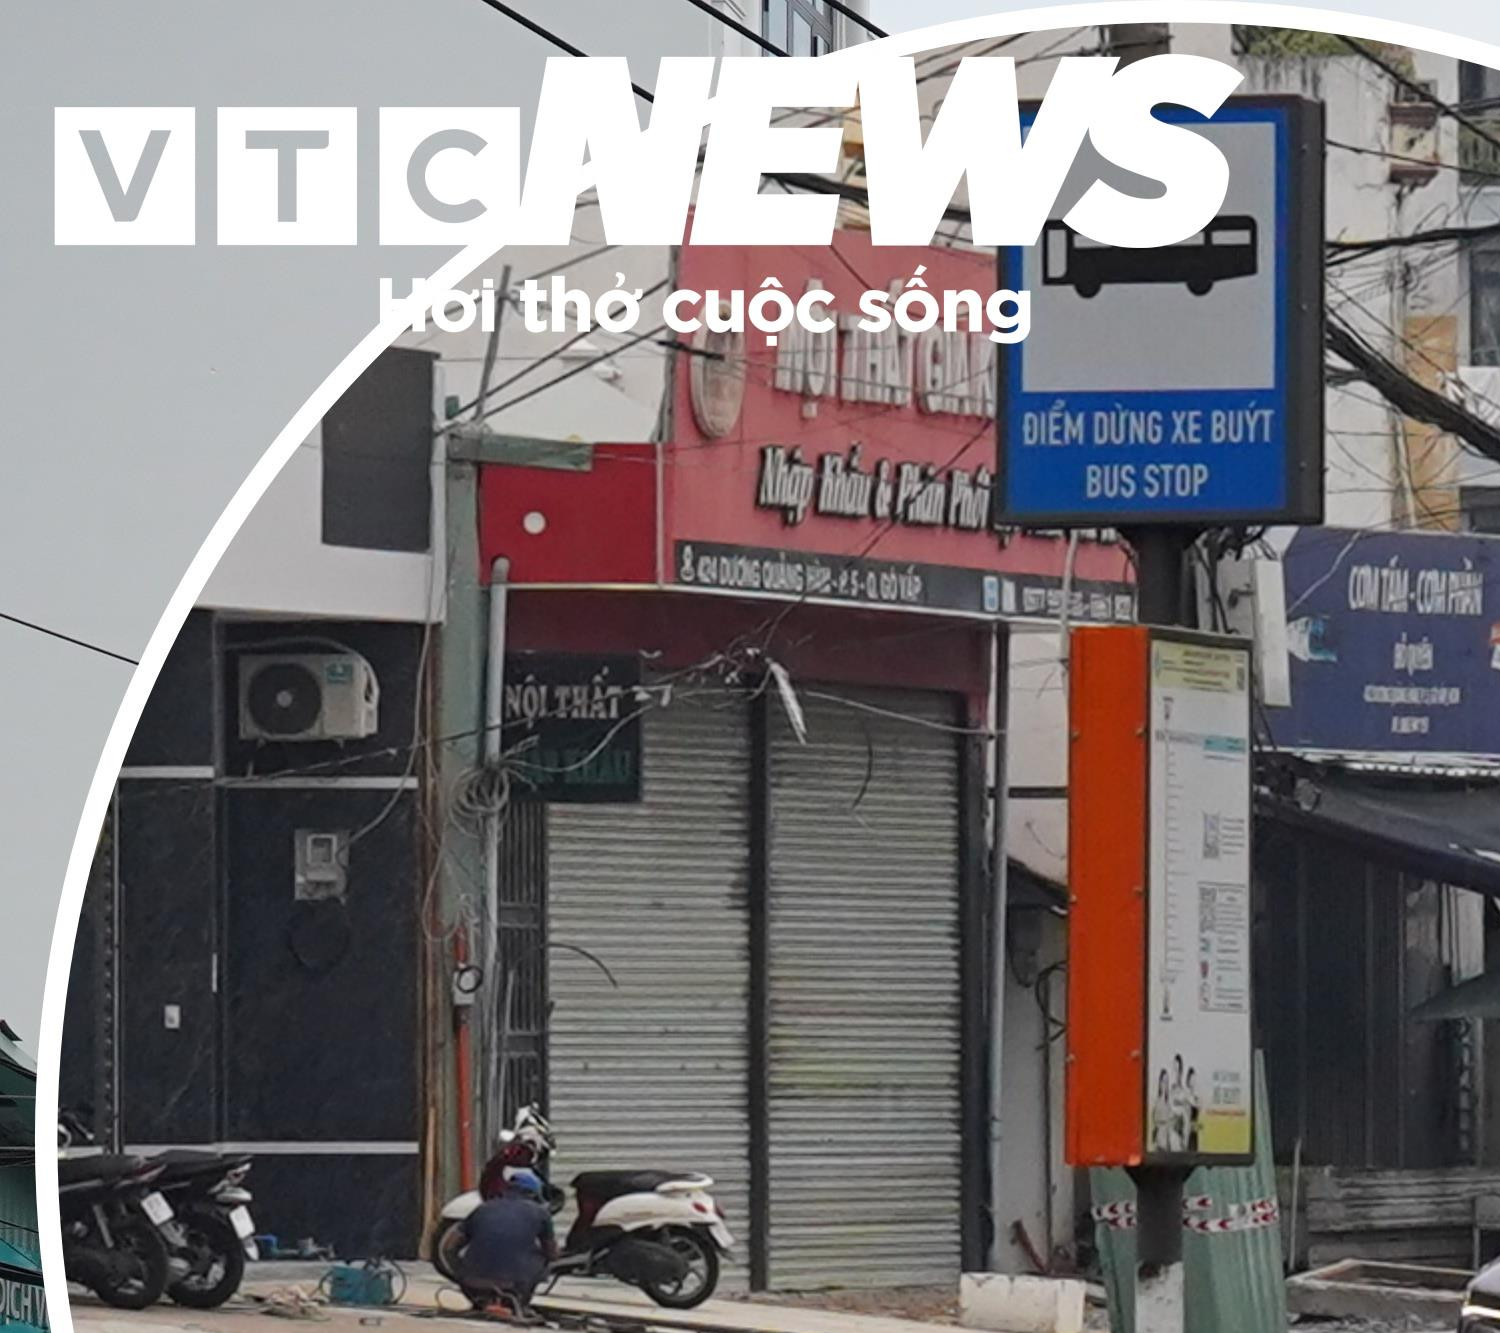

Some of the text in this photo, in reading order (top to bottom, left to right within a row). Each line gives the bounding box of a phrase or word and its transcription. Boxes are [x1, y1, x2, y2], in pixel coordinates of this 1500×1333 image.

[1022, 399, 1275, 445] ĐIỂM DỪNG XE BUÝT
[758, 444, 813, 526] Nhập
[819, 441, 870, 517] Khẩu
[876, 459, 891, 521] &
[1086, 464, 1209, 499] BUS STOP
[504, 665, 623, 729] NỘI THẤT
